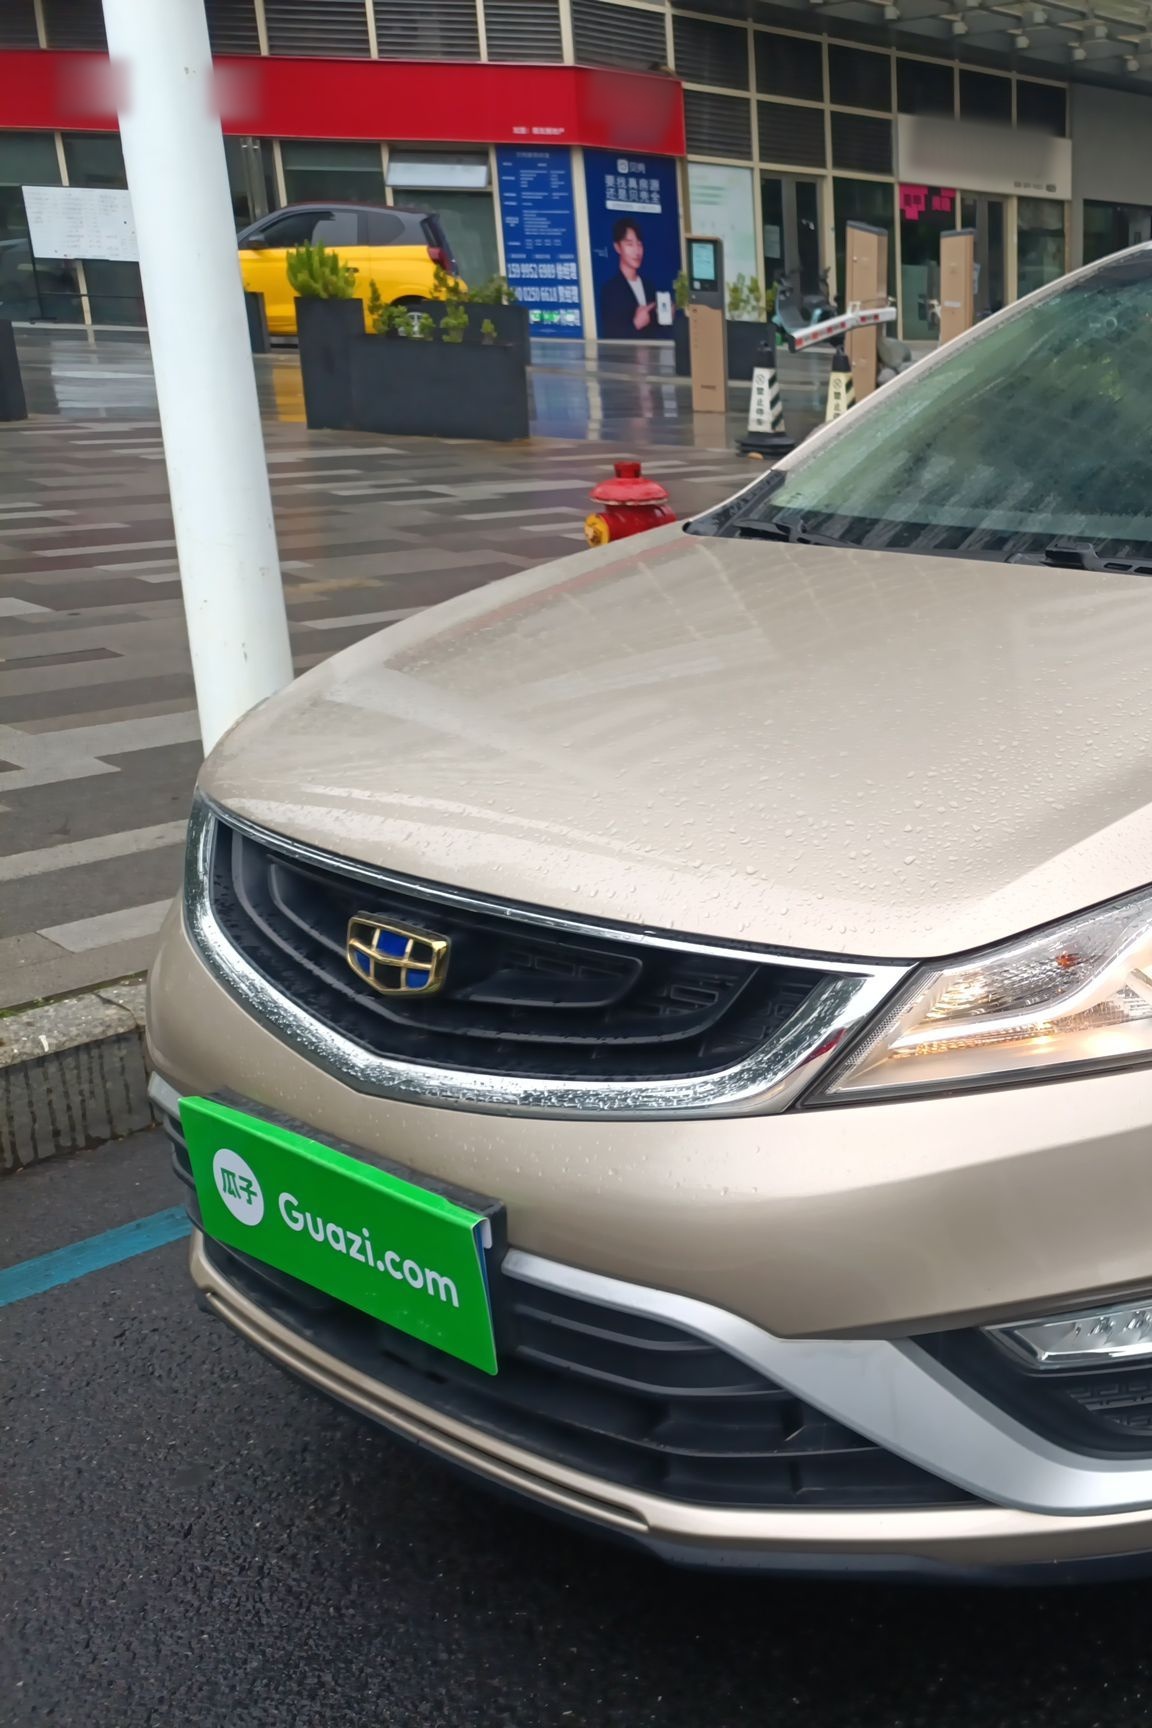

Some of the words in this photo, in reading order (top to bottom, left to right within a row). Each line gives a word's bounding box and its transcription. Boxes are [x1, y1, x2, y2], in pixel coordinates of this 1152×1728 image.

[605, 174, 660, 191] 要找真房源
[606, 187, 661, 204] 还是贝壳全
[220, 1167, 258, 1205] 瓜子
[278, 1191, 460, 1308] Guazi.com
